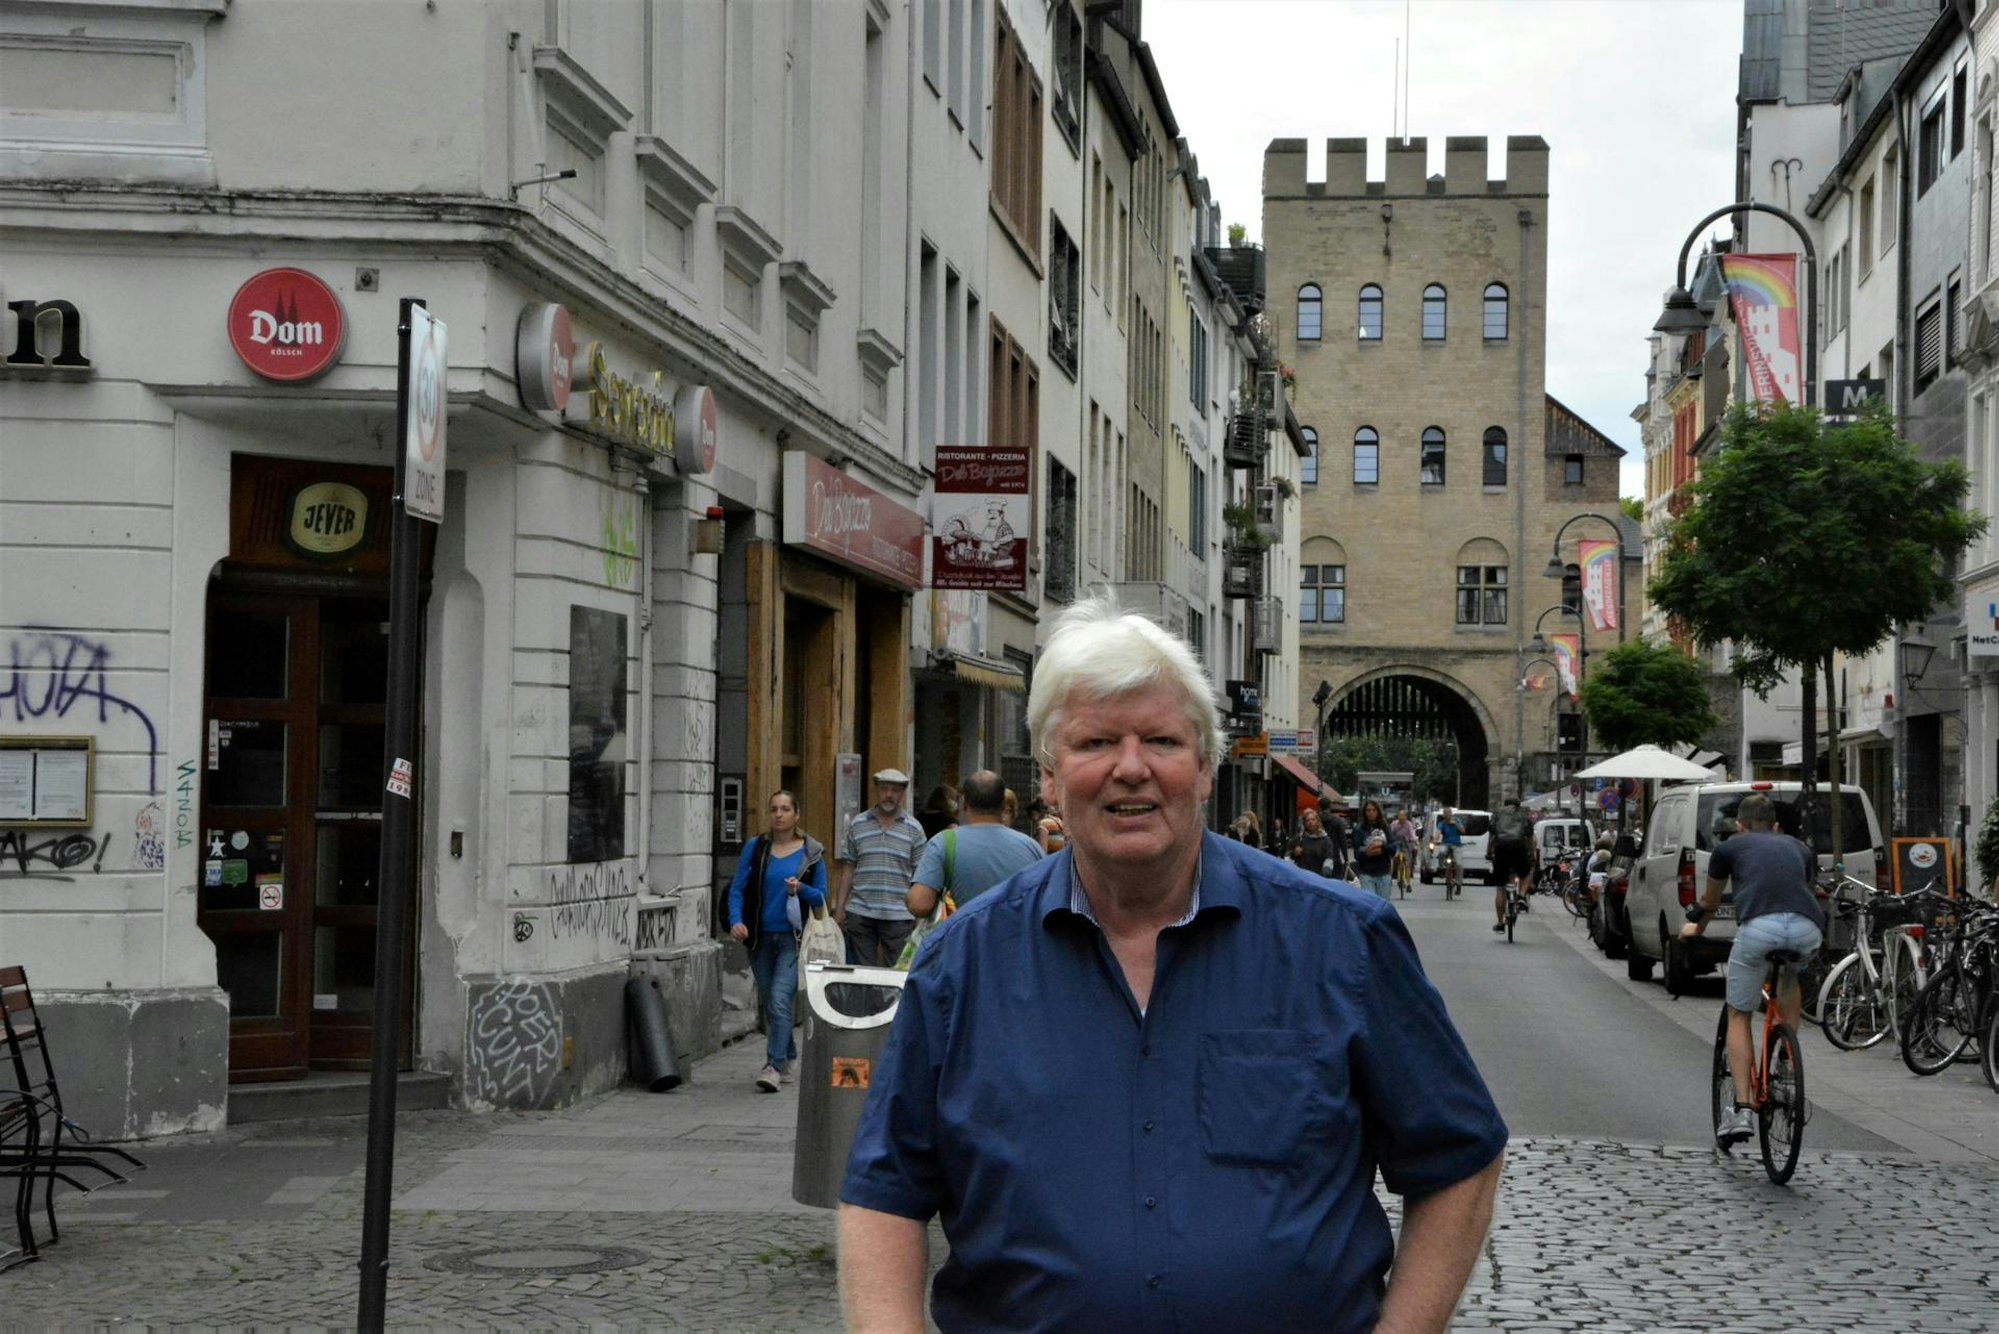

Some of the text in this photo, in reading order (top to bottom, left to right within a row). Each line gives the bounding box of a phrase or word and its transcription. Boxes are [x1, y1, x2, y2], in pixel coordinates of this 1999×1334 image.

[248, 309, 323, 345] Dom
[270, 348, 303, 356] KÖLSCH
[421, 366, 437, 428] 30
[938, 452, 1026, 461] RISTORANTE PIZZERIA
[415, 469, 436, 503] ZONE
[304, 503, 356, 536] JEVER
[1972, 635, 1999, 645] NetC
